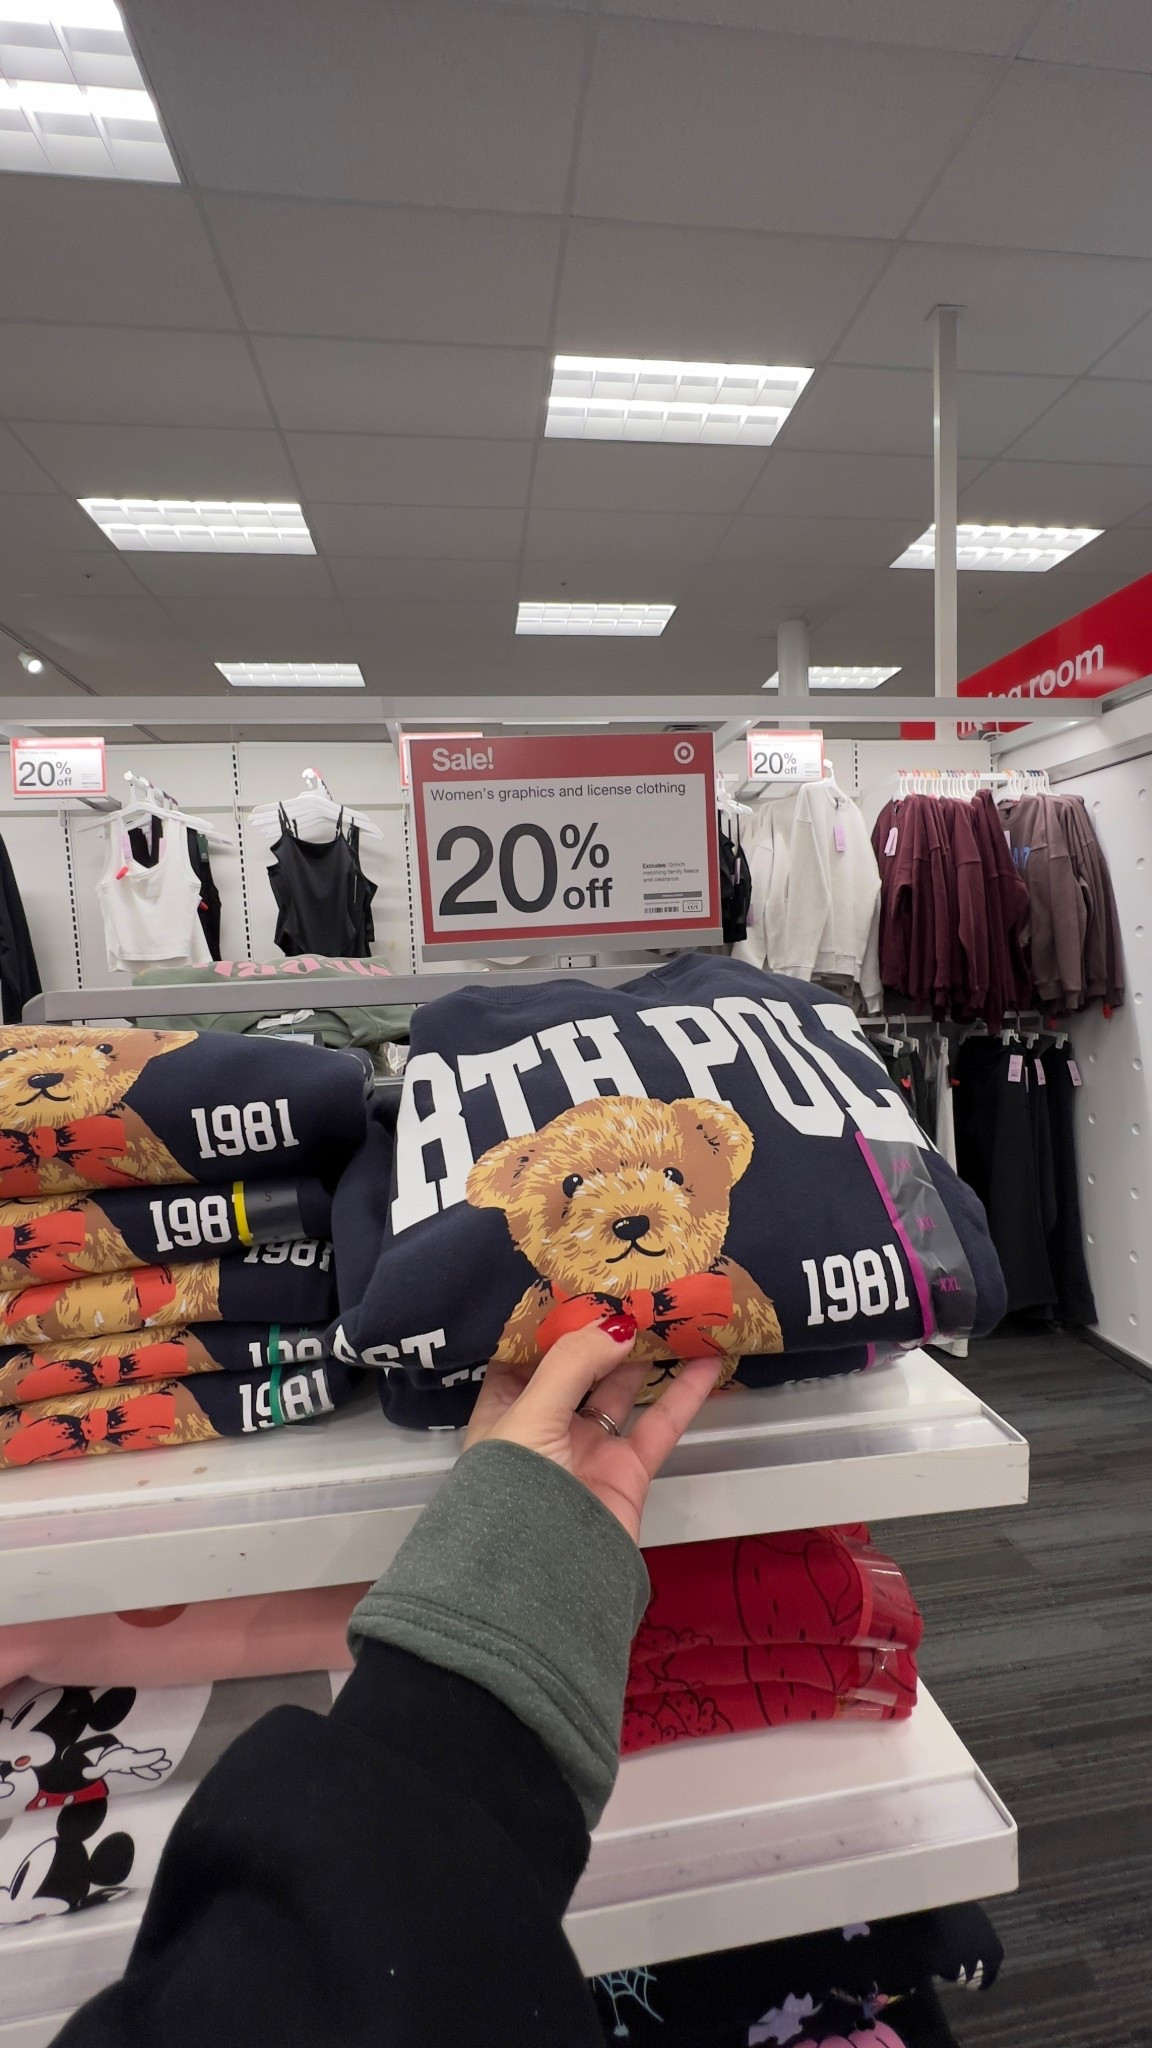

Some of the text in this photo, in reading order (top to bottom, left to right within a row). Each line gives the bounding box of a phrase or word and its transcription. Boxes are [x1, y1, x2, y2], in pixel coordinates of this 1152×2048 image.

[1029, 644, 1104, 699] room
[432, 747, 494, 772] Sale!
[753, 752, 797, 774] 20%
[784, 767, 797, 775] off
[18, 761, 72, 787] 20%
[56, 777, 72, 787] off
[430, 782, 686, 802] Women's graphics and license clothing
[436, 822, 613, 916] 20% off
[191, 1098, 300, 1160] 1981
[801, 1243, 910, 1326] 1981
[938, 1276, 962, 1292] XXL
